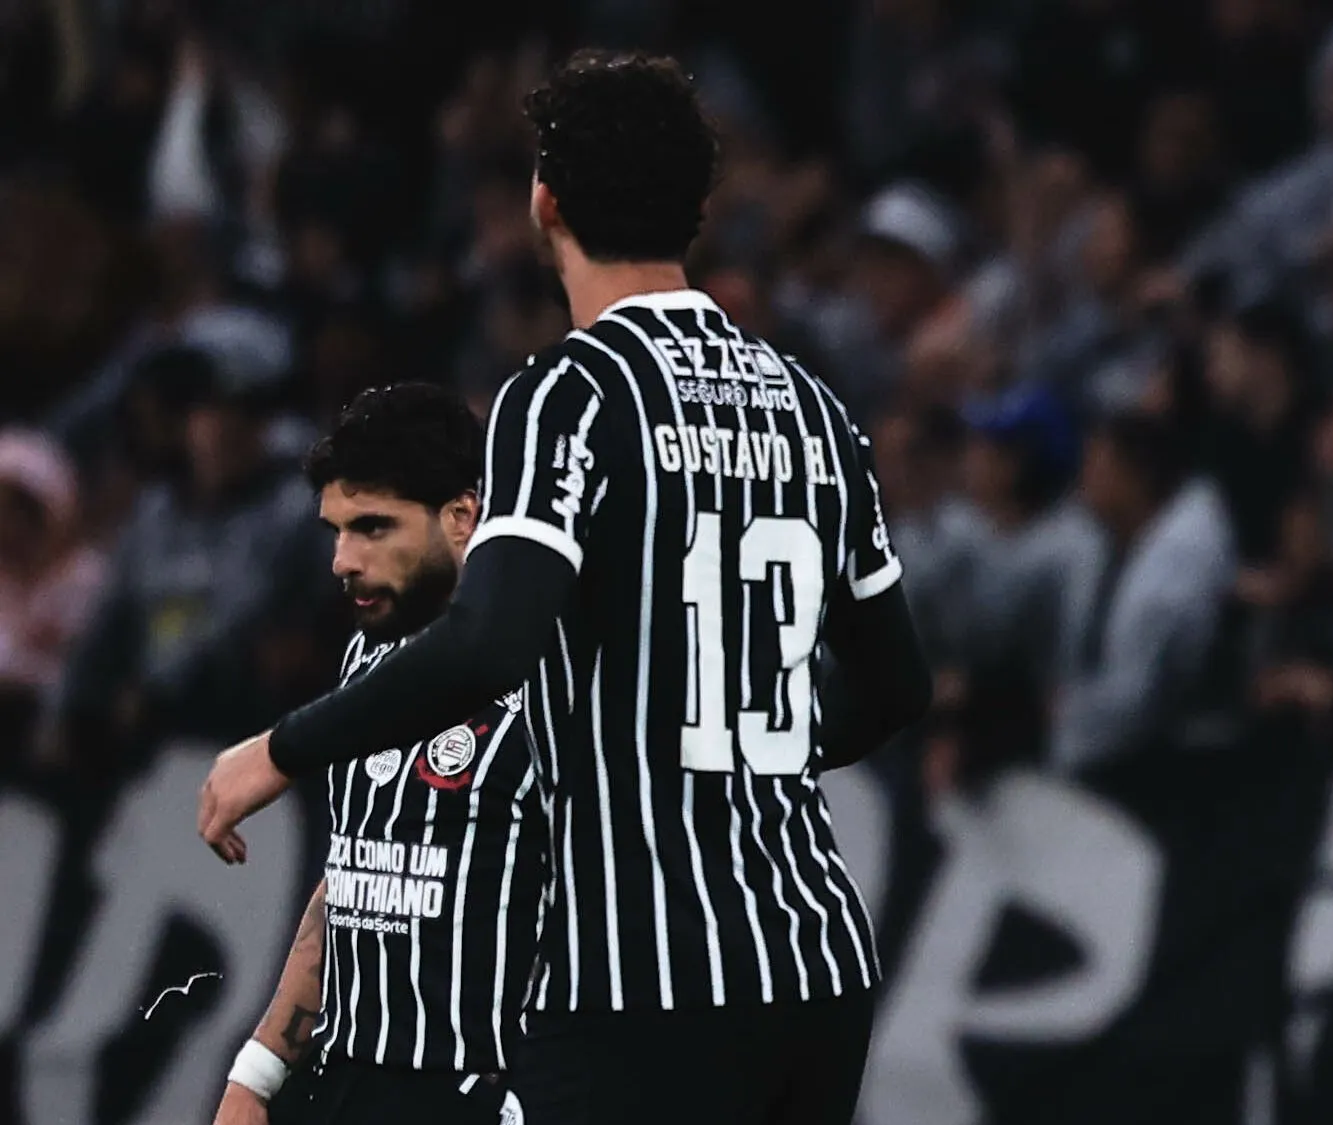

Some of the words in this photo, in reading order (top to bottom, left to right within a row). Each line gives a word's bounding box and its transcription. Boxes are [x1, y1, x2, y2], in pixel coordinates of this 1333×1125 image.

[751, 386, 797, 412] AUTO
[654, 424, 793, 483] GUSTAVO
[803, 435, 838, 486] H.
[681, 511, 825, 776] 13
[355, 839, 406, 874] COMO
[409, 844, 448, 877] UM
[325, 867, 445, 919] RINTHIANO
